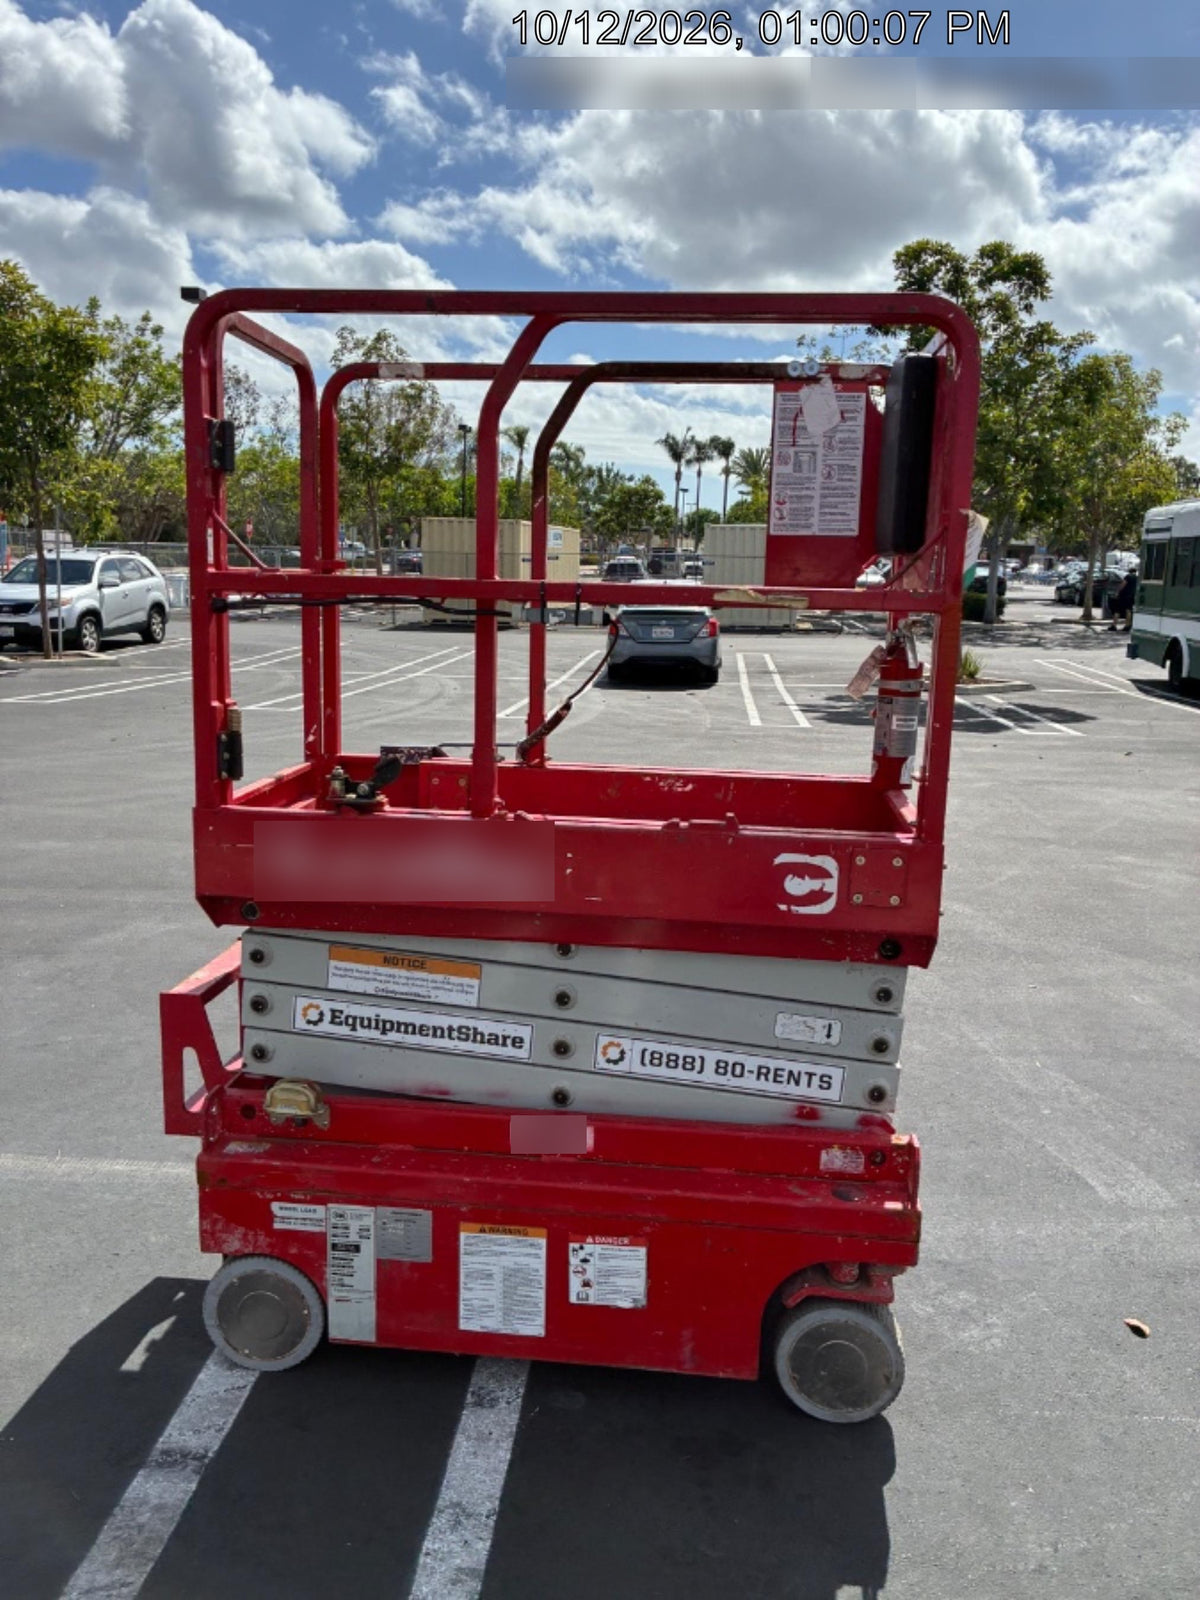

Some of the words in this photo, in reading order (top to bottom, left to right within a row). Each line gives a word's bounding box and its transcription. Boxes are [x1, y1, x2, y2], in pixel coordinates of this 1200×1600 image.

[383, 955, 428, 970] NOTICE
[328, 1008, 525, 1050] EquipmentShare
[640, 1048, 705, 1075] (888)
[714, 1059, 833, 1091] 80-RENTS
[488, 1227, 529, 1236] WARNING
[595, 1236, 630, 1245] DANGER
